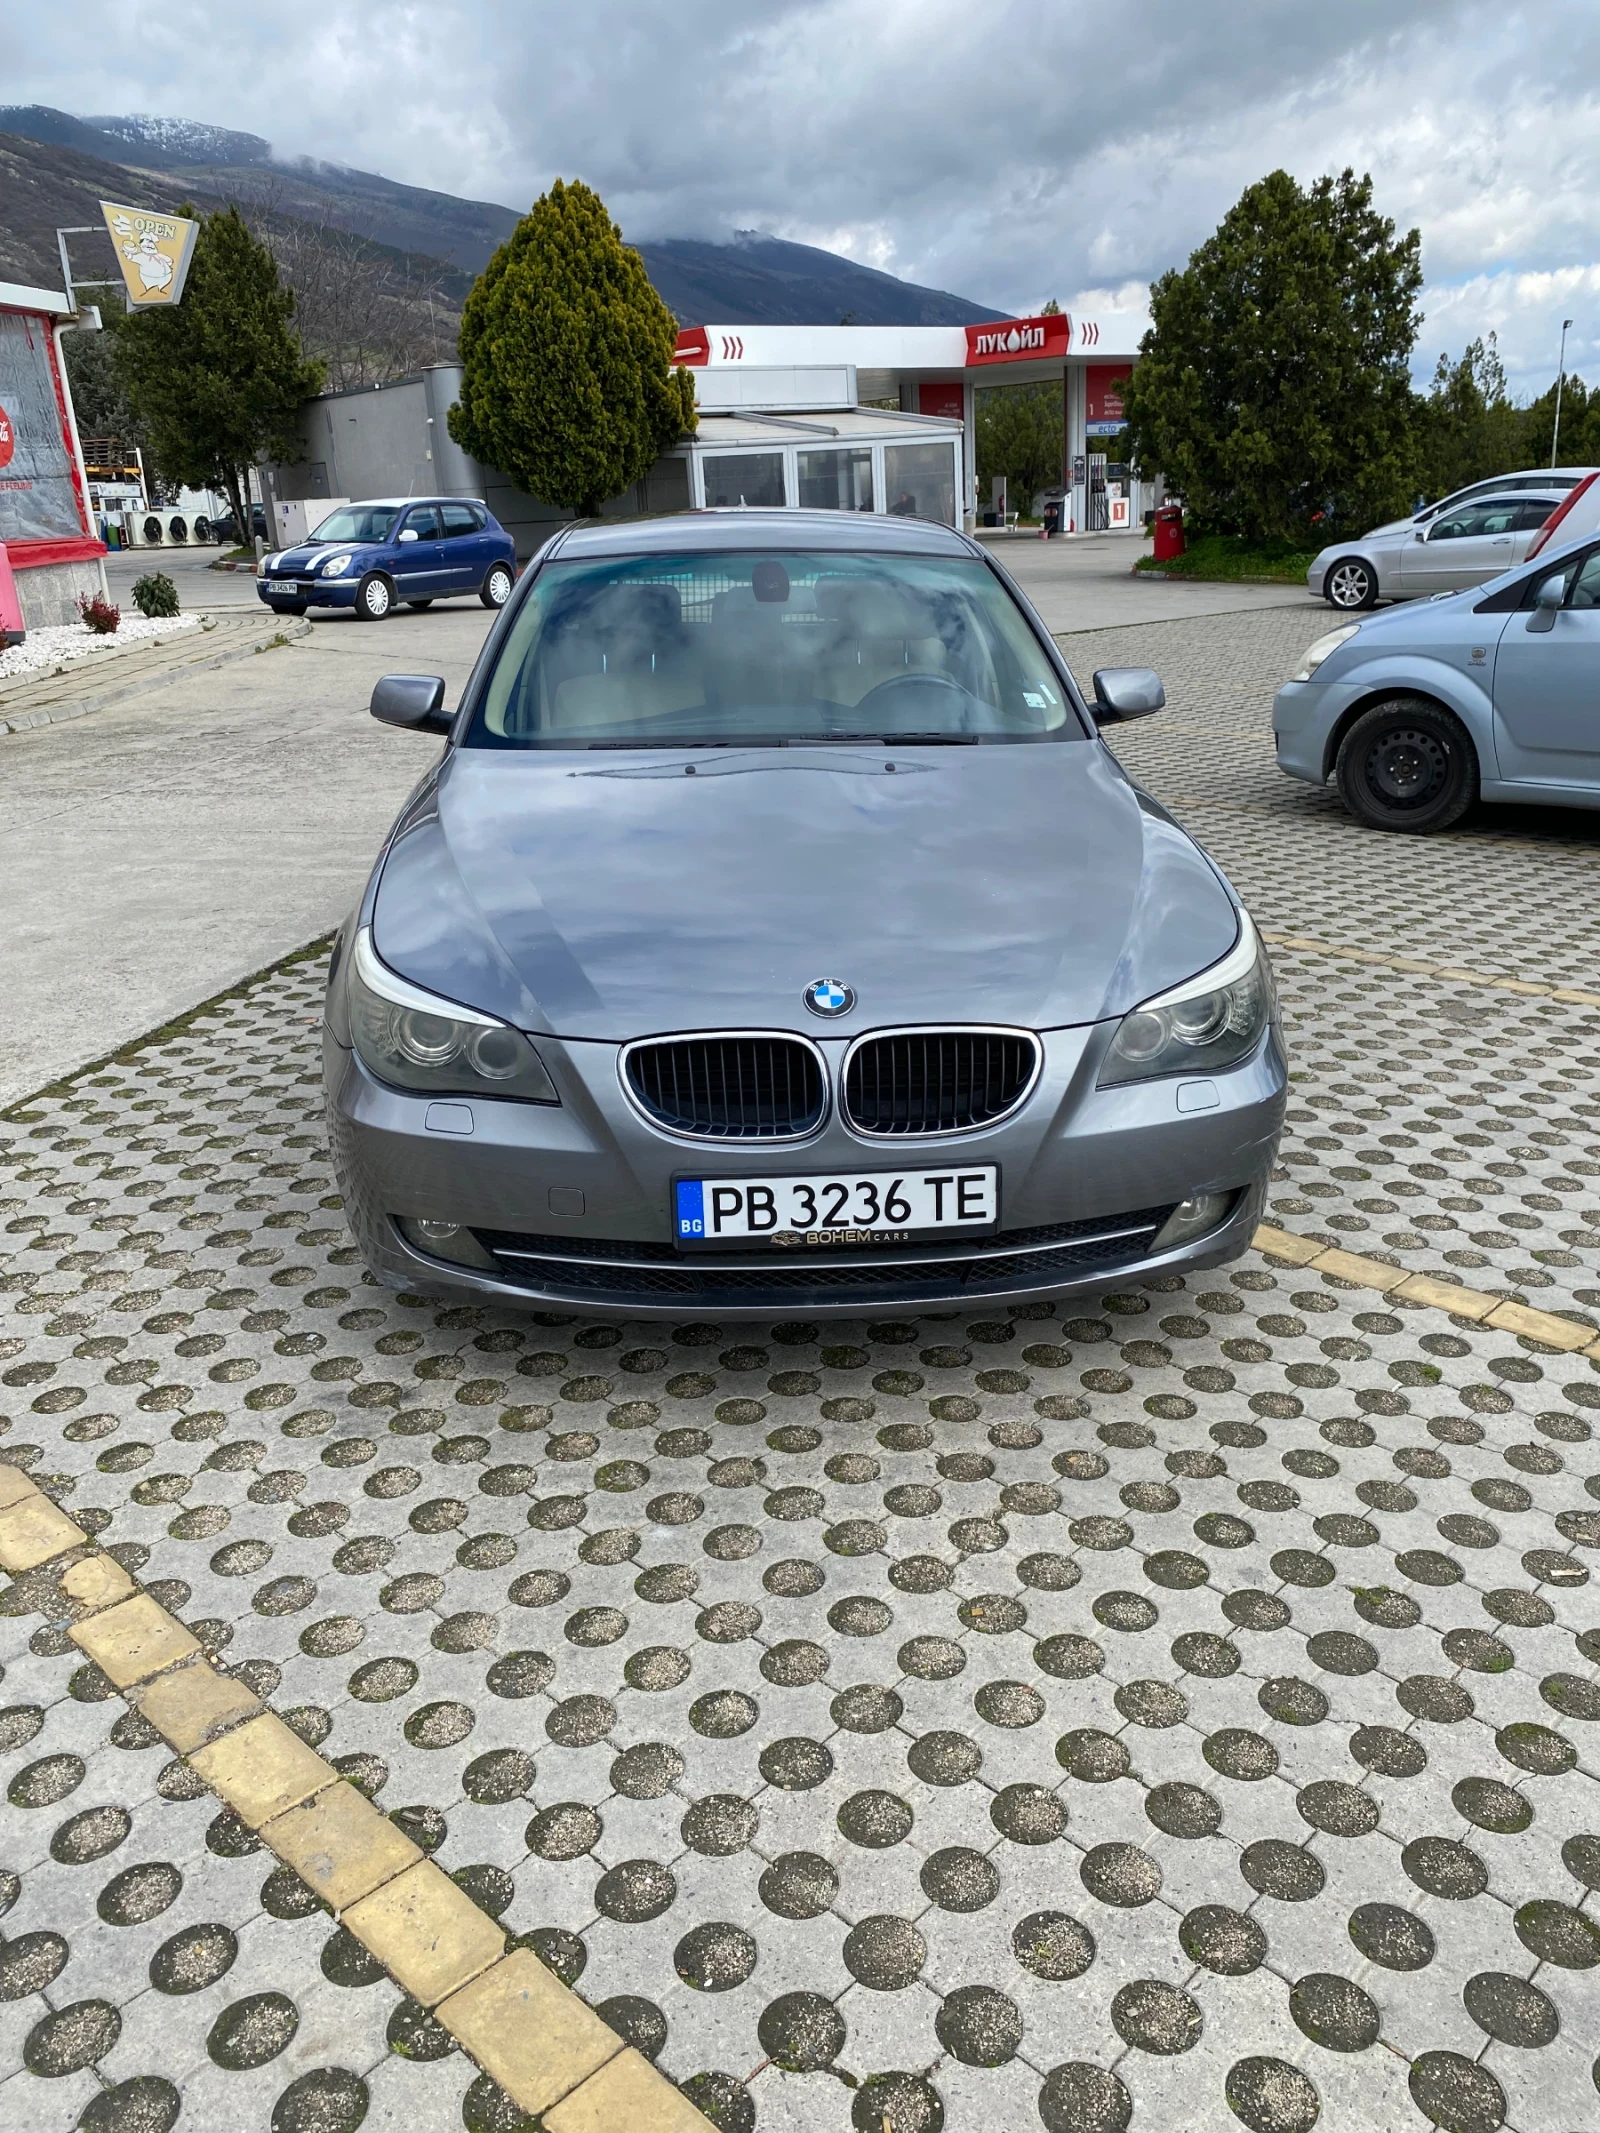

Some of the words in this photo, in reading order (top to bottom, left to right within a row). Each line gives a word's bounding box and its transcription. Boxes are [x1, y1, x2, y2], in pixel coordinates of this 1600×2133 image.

[134, 218, 176, 239] OPEN
[975, 325, 1044, 354] ЛУКОЙЛ
[1098, 424, 1117, 434] ecto
[810, 980, 849, 991] BMW
[712, 1186, 777, 1232] PB
[790, 1179, 911, 1228] 3236
[924, 1174, 987, 1221] TE
[681, 1219, 702, 1233] BG
[806, 1230, 870, 1244] BOHEM
[874, 1232, 909, 1241] CARS
